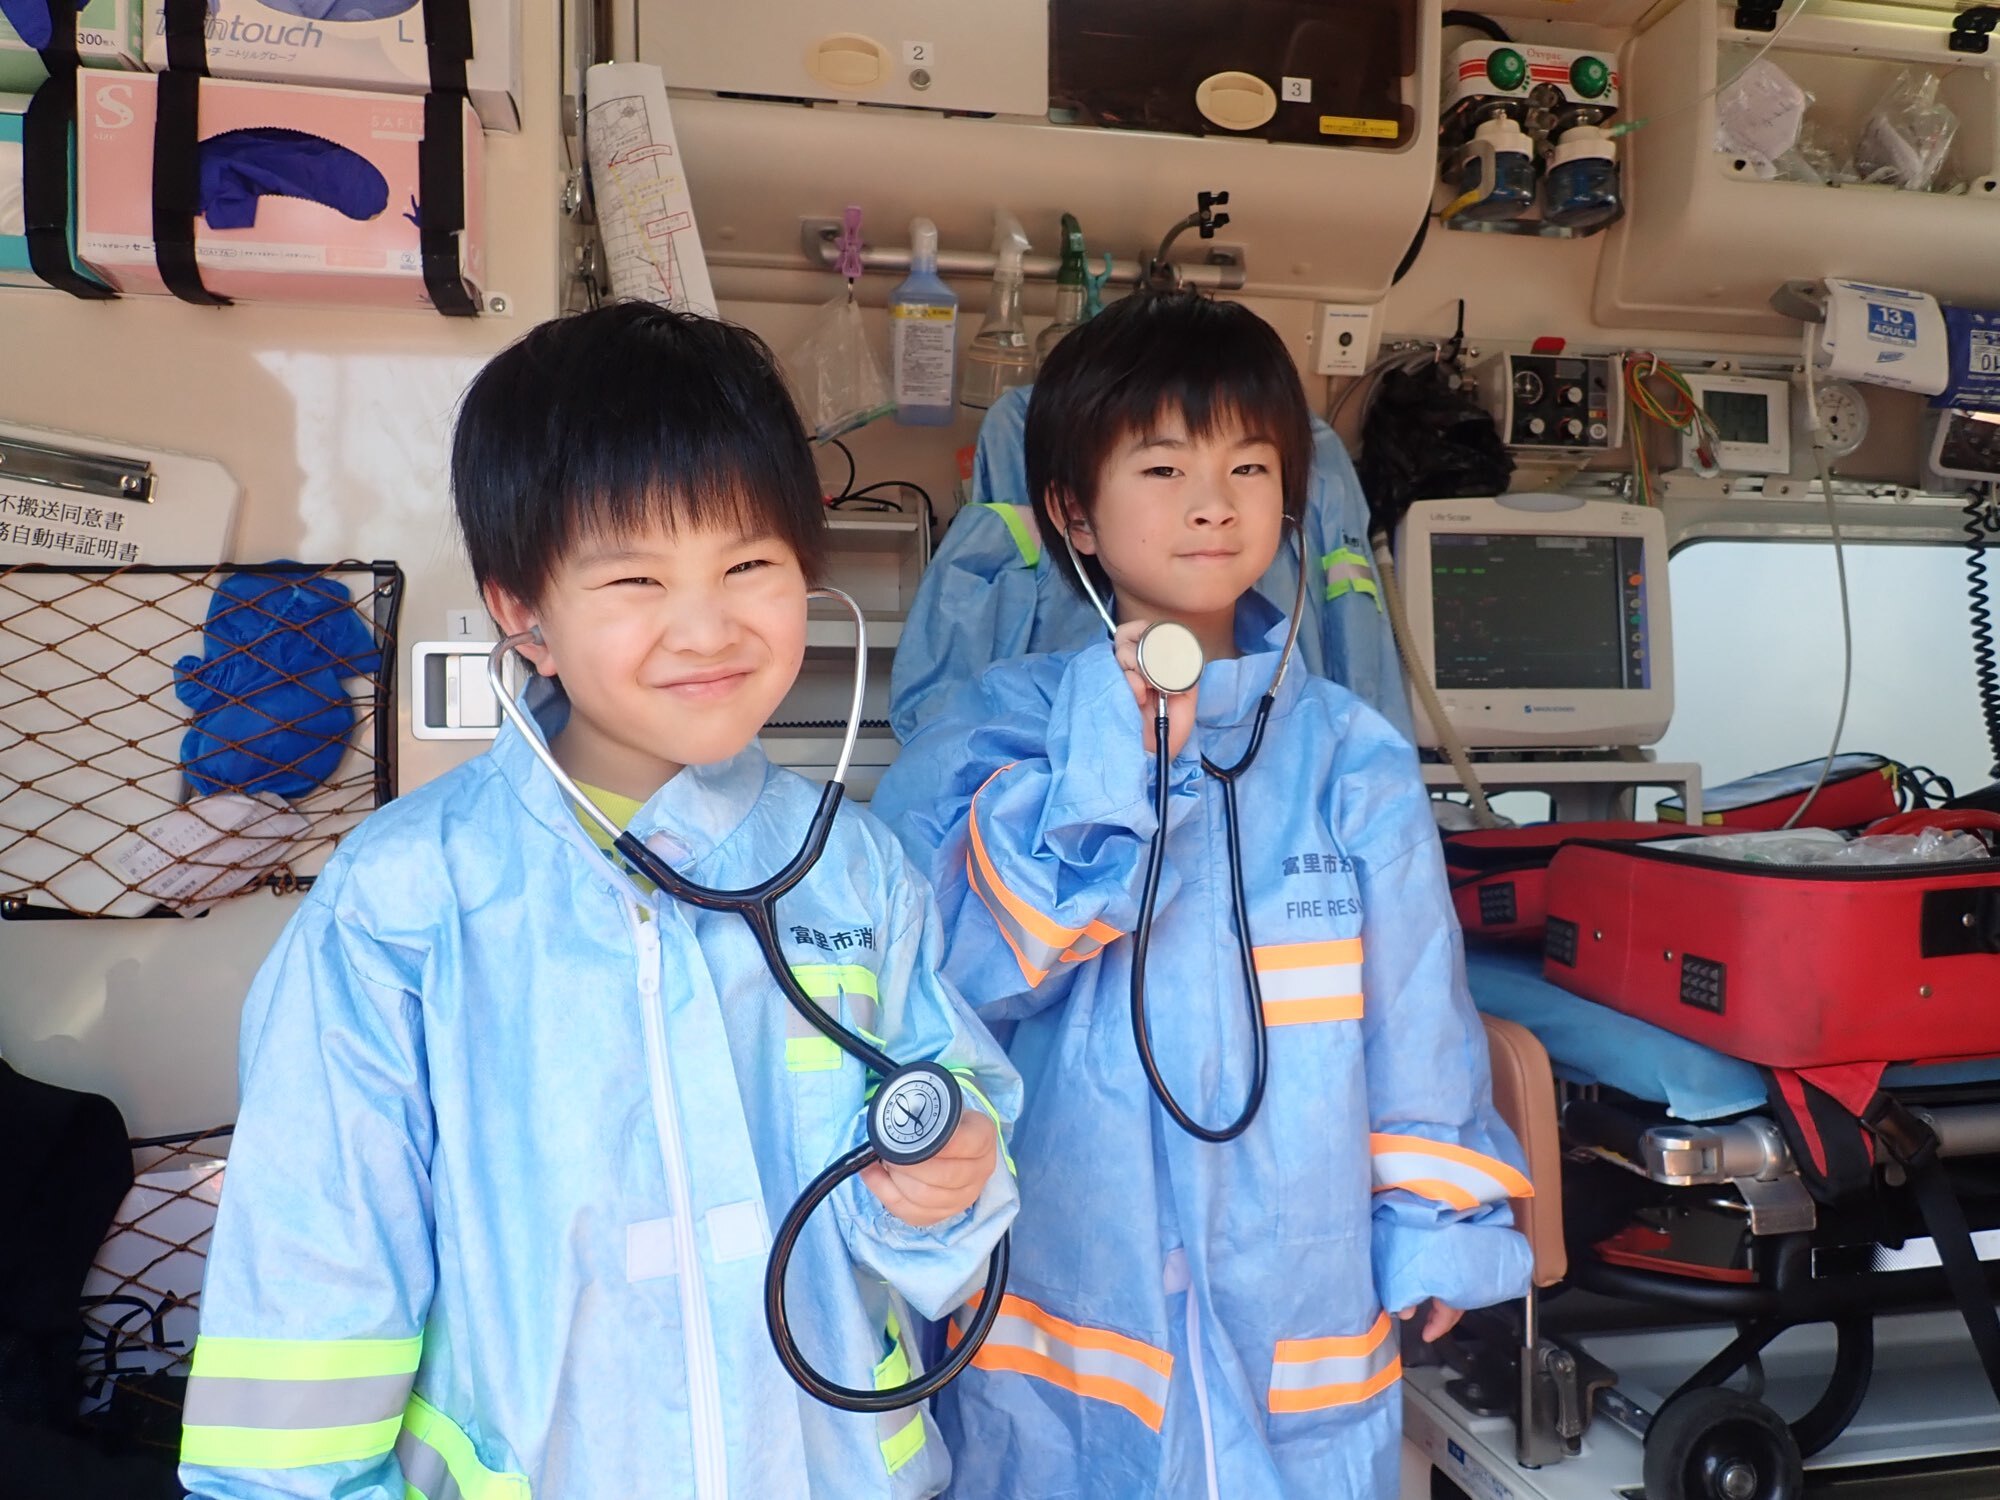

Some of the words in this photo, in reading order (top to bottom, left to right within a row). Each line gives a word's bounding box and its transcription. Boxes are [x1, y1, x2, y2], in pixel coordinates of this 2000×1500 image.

[399, 19, 414, 43] L
[913, 45, 924, 60] 2
[1291, 82, 1302, 97] 3
[95, 84, 134, 129] S
[1878, 307, 1903, 324] 13
[1873, 324, 1911, 338] ADULT
[459, 616, 472, 635] 1
[1286, 899, 1323, 919] FIRE
[789, 925, 877, 952] 富里市消
